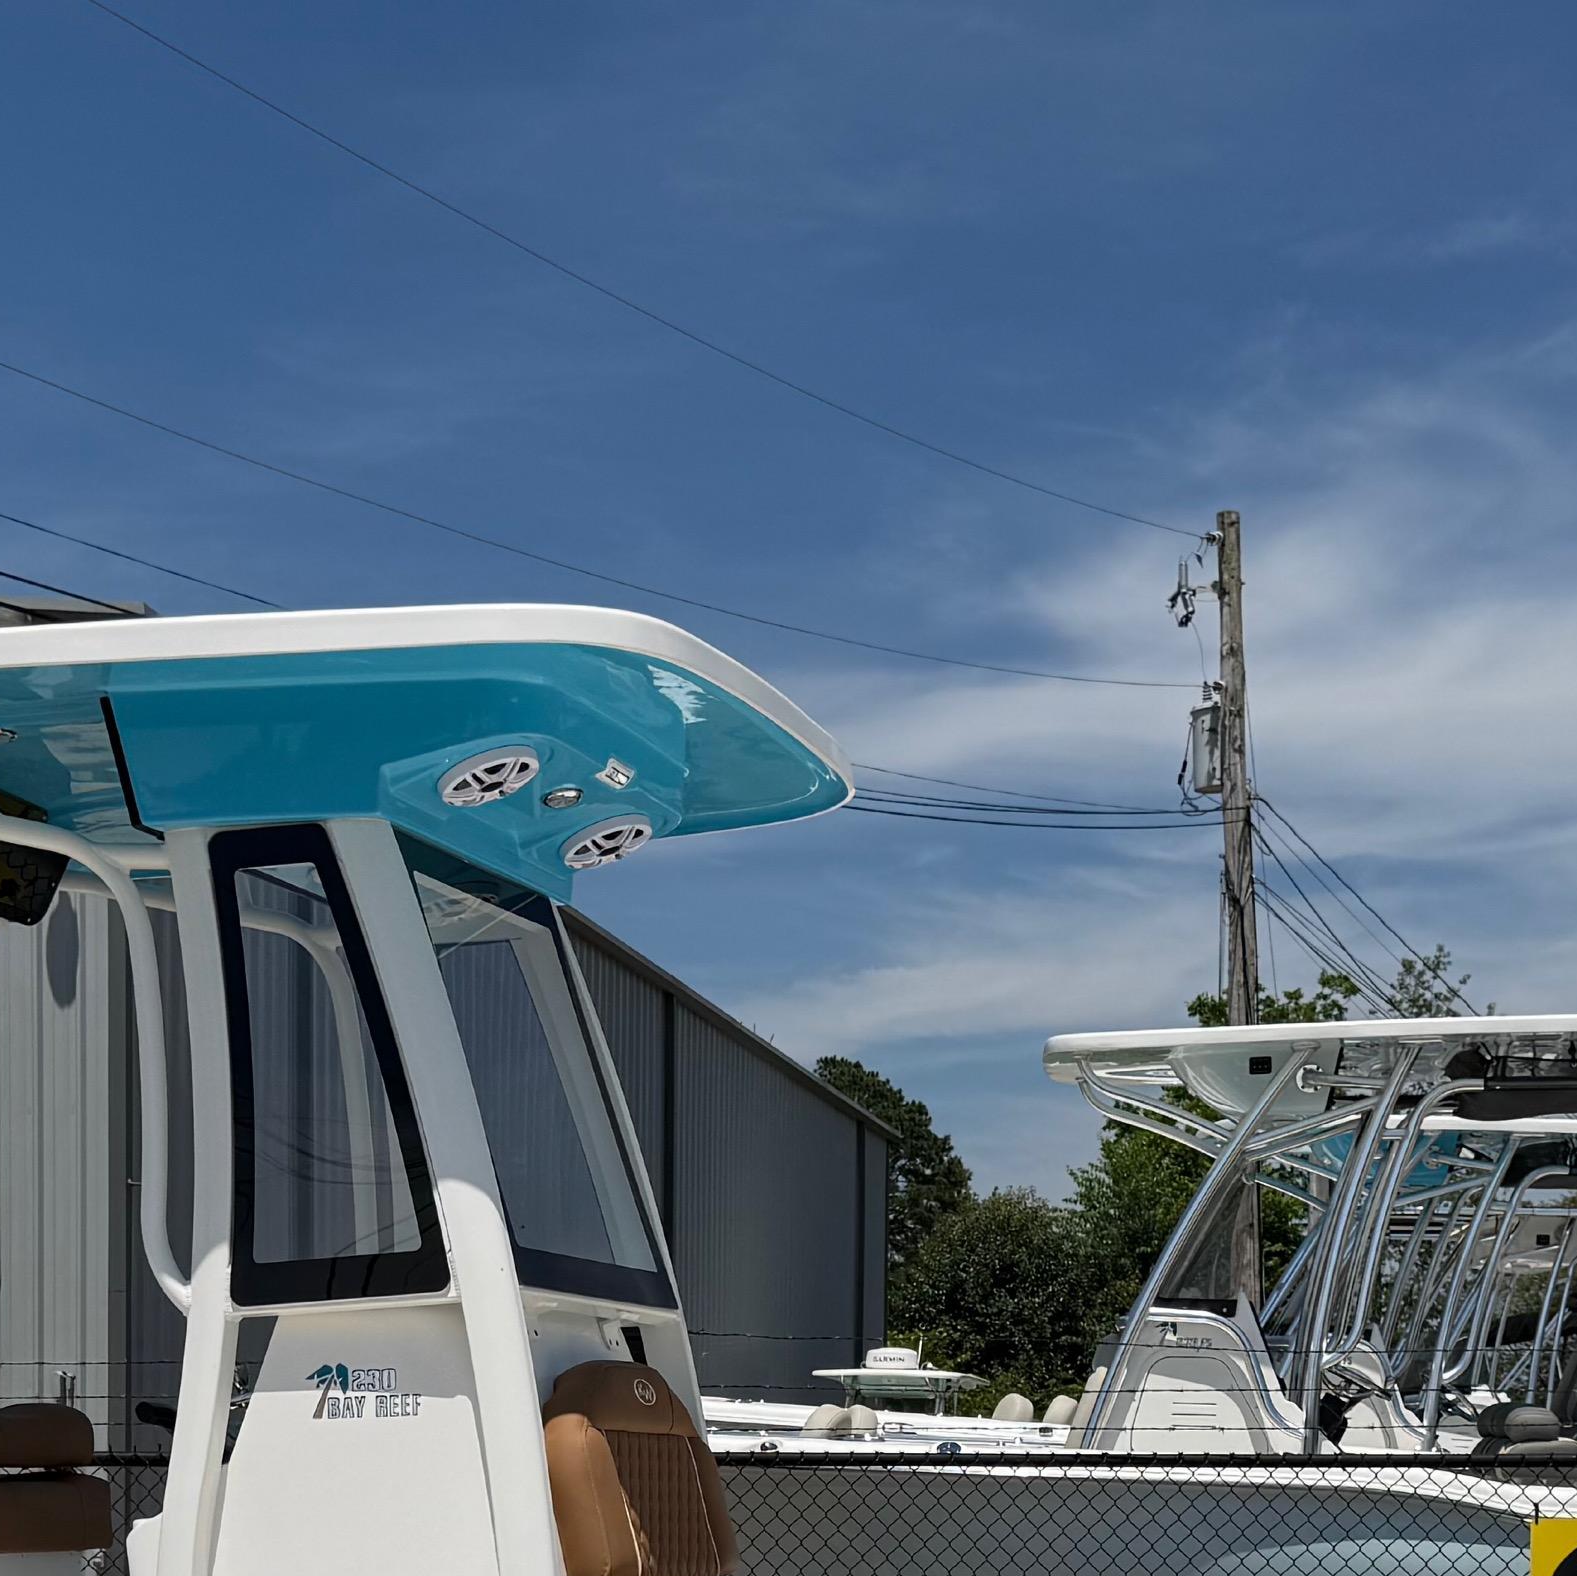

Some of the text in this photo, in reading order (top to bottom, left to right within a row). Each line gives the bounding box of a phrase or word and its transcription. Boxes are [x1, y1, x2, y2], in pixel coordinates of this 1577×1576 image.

[351, 1368, 397, 1393] 230
[327, 1394, 422, 1420] BAY REEF
